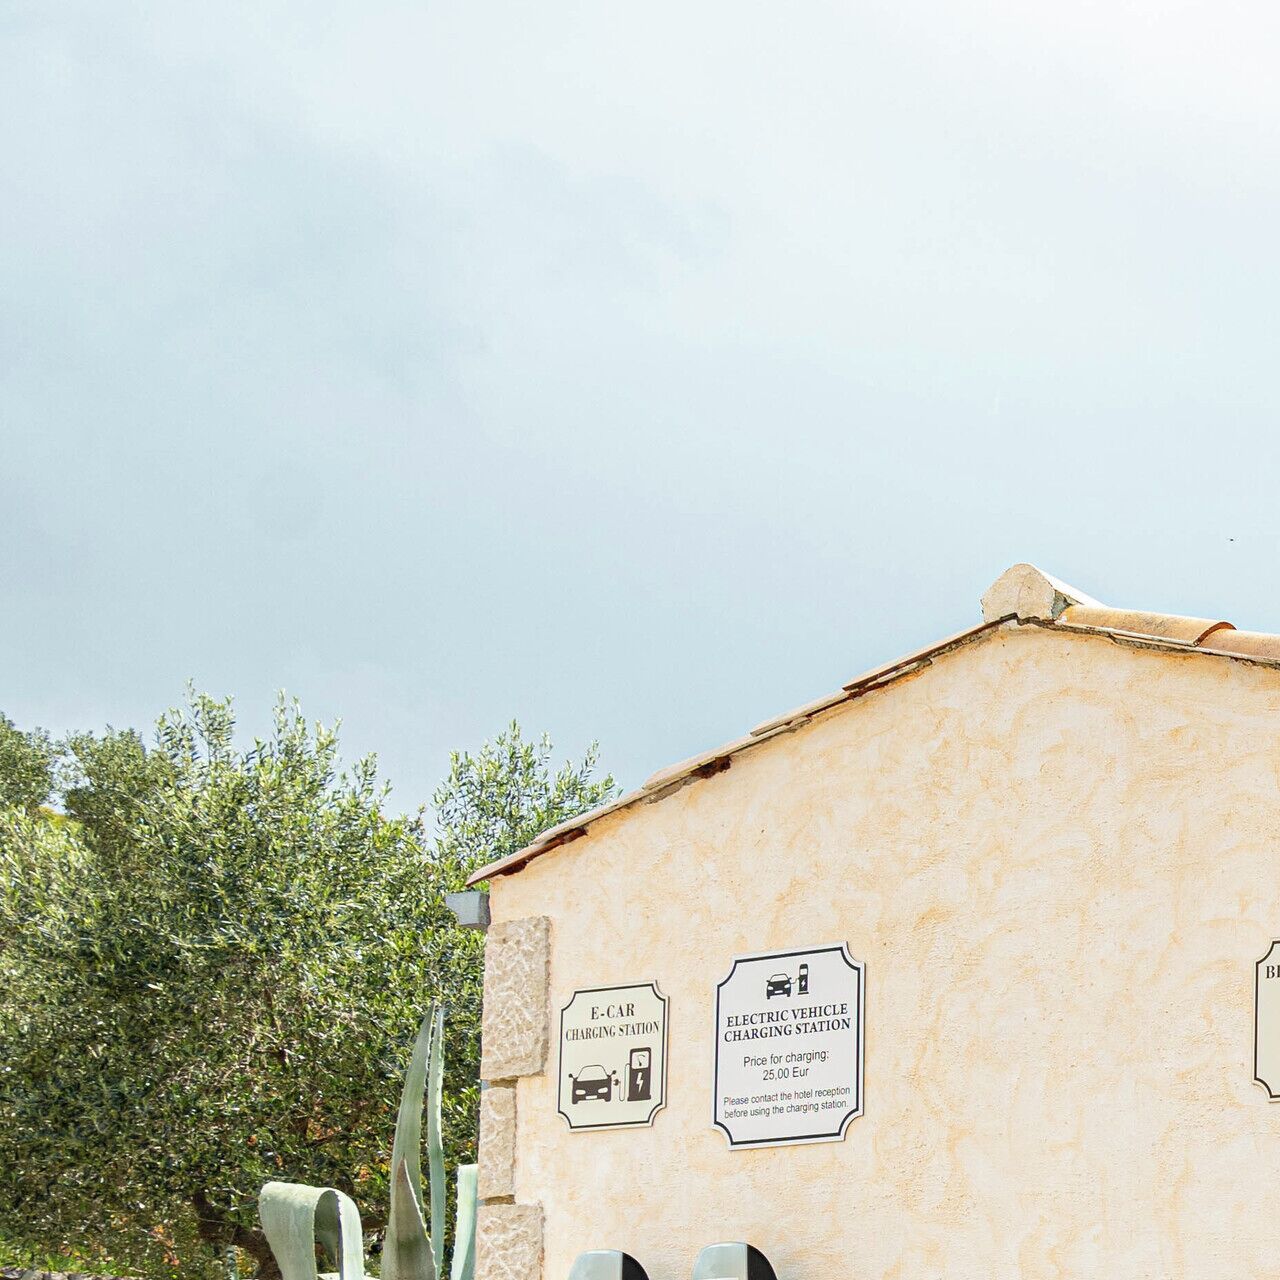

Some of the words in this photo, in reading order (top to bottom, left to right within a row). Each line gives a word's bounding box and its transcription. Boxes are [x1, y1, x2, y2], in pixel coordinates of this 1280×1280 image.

[591, 1003, 635, 1020] E-CAR
[726, 1009, 789, 1028] ELECTRIC
[791, 1003, 848, 1020] VEHICLE
[565, 1025, 616, 1041] CHARGING
[618, 1020, 660, 1037] STATION
[724, 1024, 792, 1042] CHARGING
[795, 1018, 851, 1035] STATION
[743, 1056, 767, 1067] Price
[770, 1053, 783, 1065] for
[785, 1049, 829, 1064] charging:
[792, 1066, 809, 1078] Eur
[723, 1096, 749, 1106] Please
[751, 1093, 779, 1104] contact
[780, 1091, 792, 1101] the
[794, 1088, 813, 1099] hotel
[815, 1086, 851, 1098] reception
[724, 1109, 748, 1119] before
[750, 1106, 770, 1118] using
[772, 1104, 784, 1114] the
[786, 1101, 819, 1115] charging
[820, 1099, 849, 1110] station.
